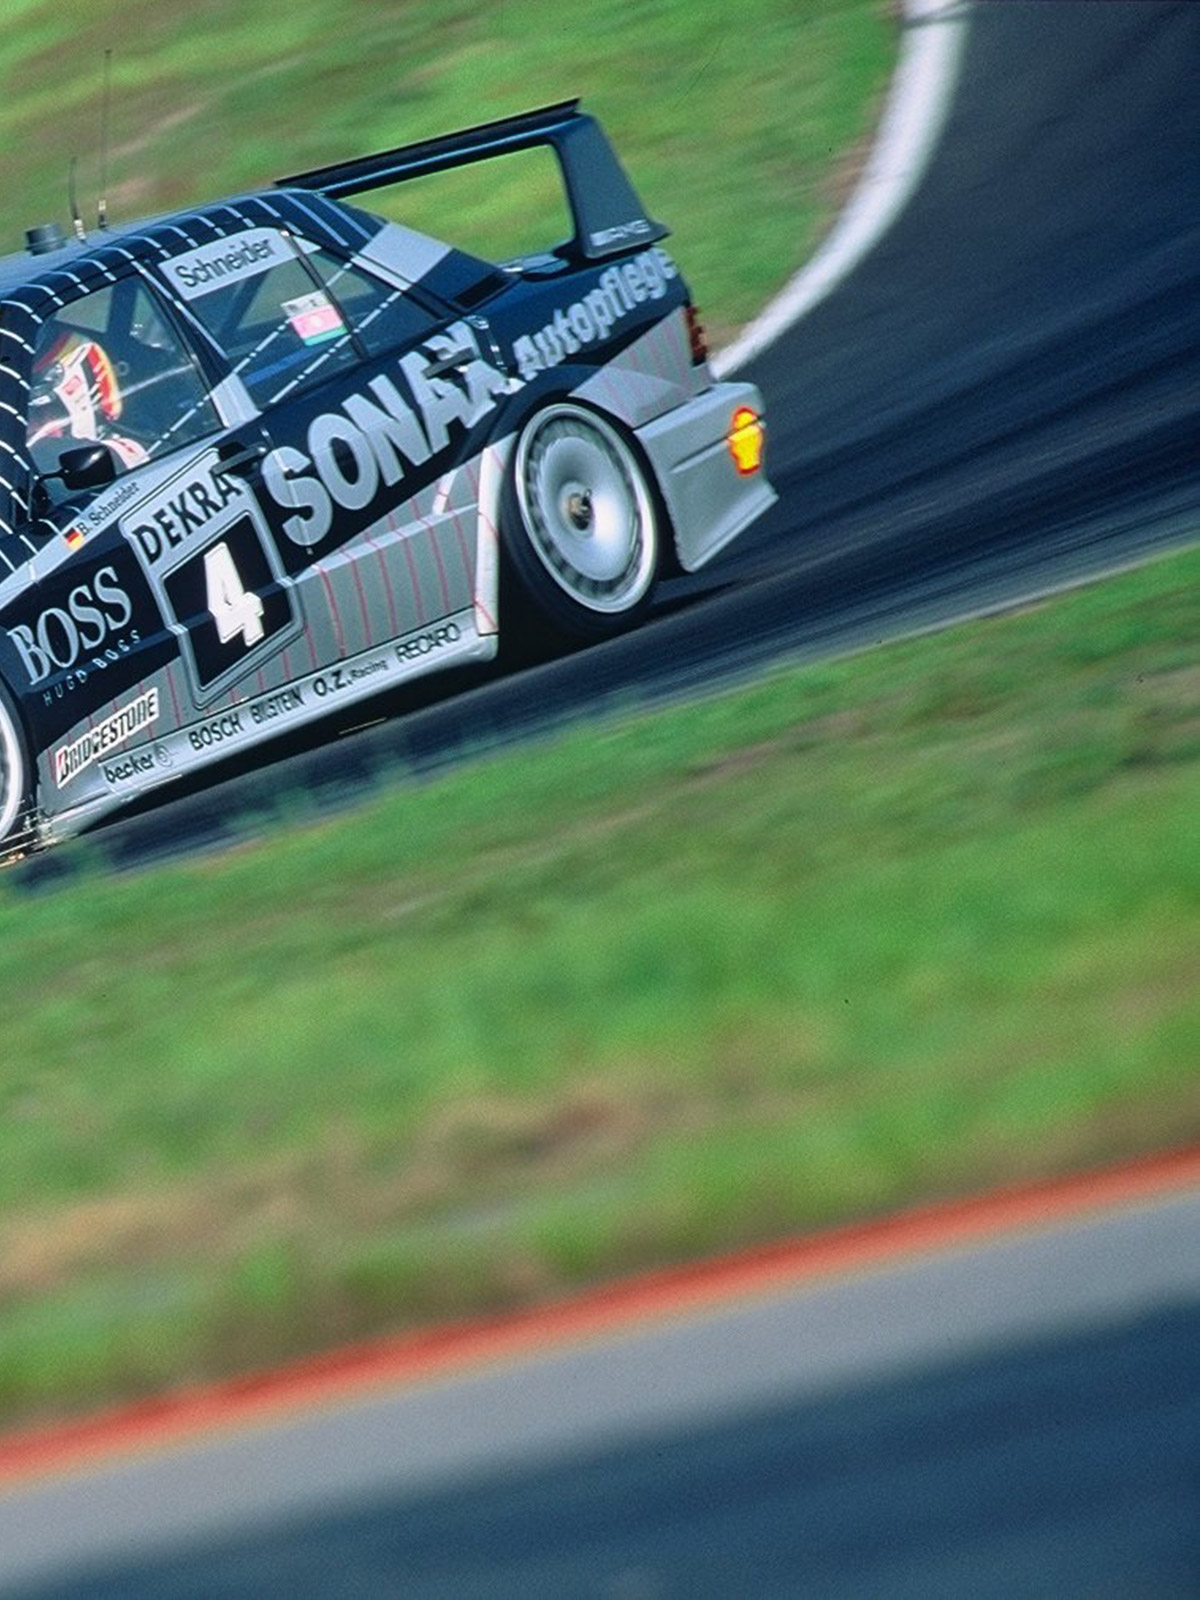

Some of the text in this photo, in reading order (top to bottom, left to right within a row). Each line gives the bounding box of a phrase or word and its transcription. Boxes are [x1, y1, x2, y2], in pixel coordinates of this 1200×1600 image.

[174, 236, 275, 288] Schneider
[512, 247, 678, 381] Autopflege
[261, 318, 526, 547] SONAX
[88, 482, 140, 526] Schneider
[131, 471, 242, 565] DEKRA
[6, 566, 132, 686] BOSS
[203, 541, 265, 647] 4
[43, 629, 141, 707] HUGO BOSS
[395, 622, 461, 663] RECARO
[57, 690, 157, 786] BRIDGESTONE
[188, 713, 245, 751] BOSCH
[251, 686, 306, 725] BILSTEIN
[103, 753, 155, 784] becker
